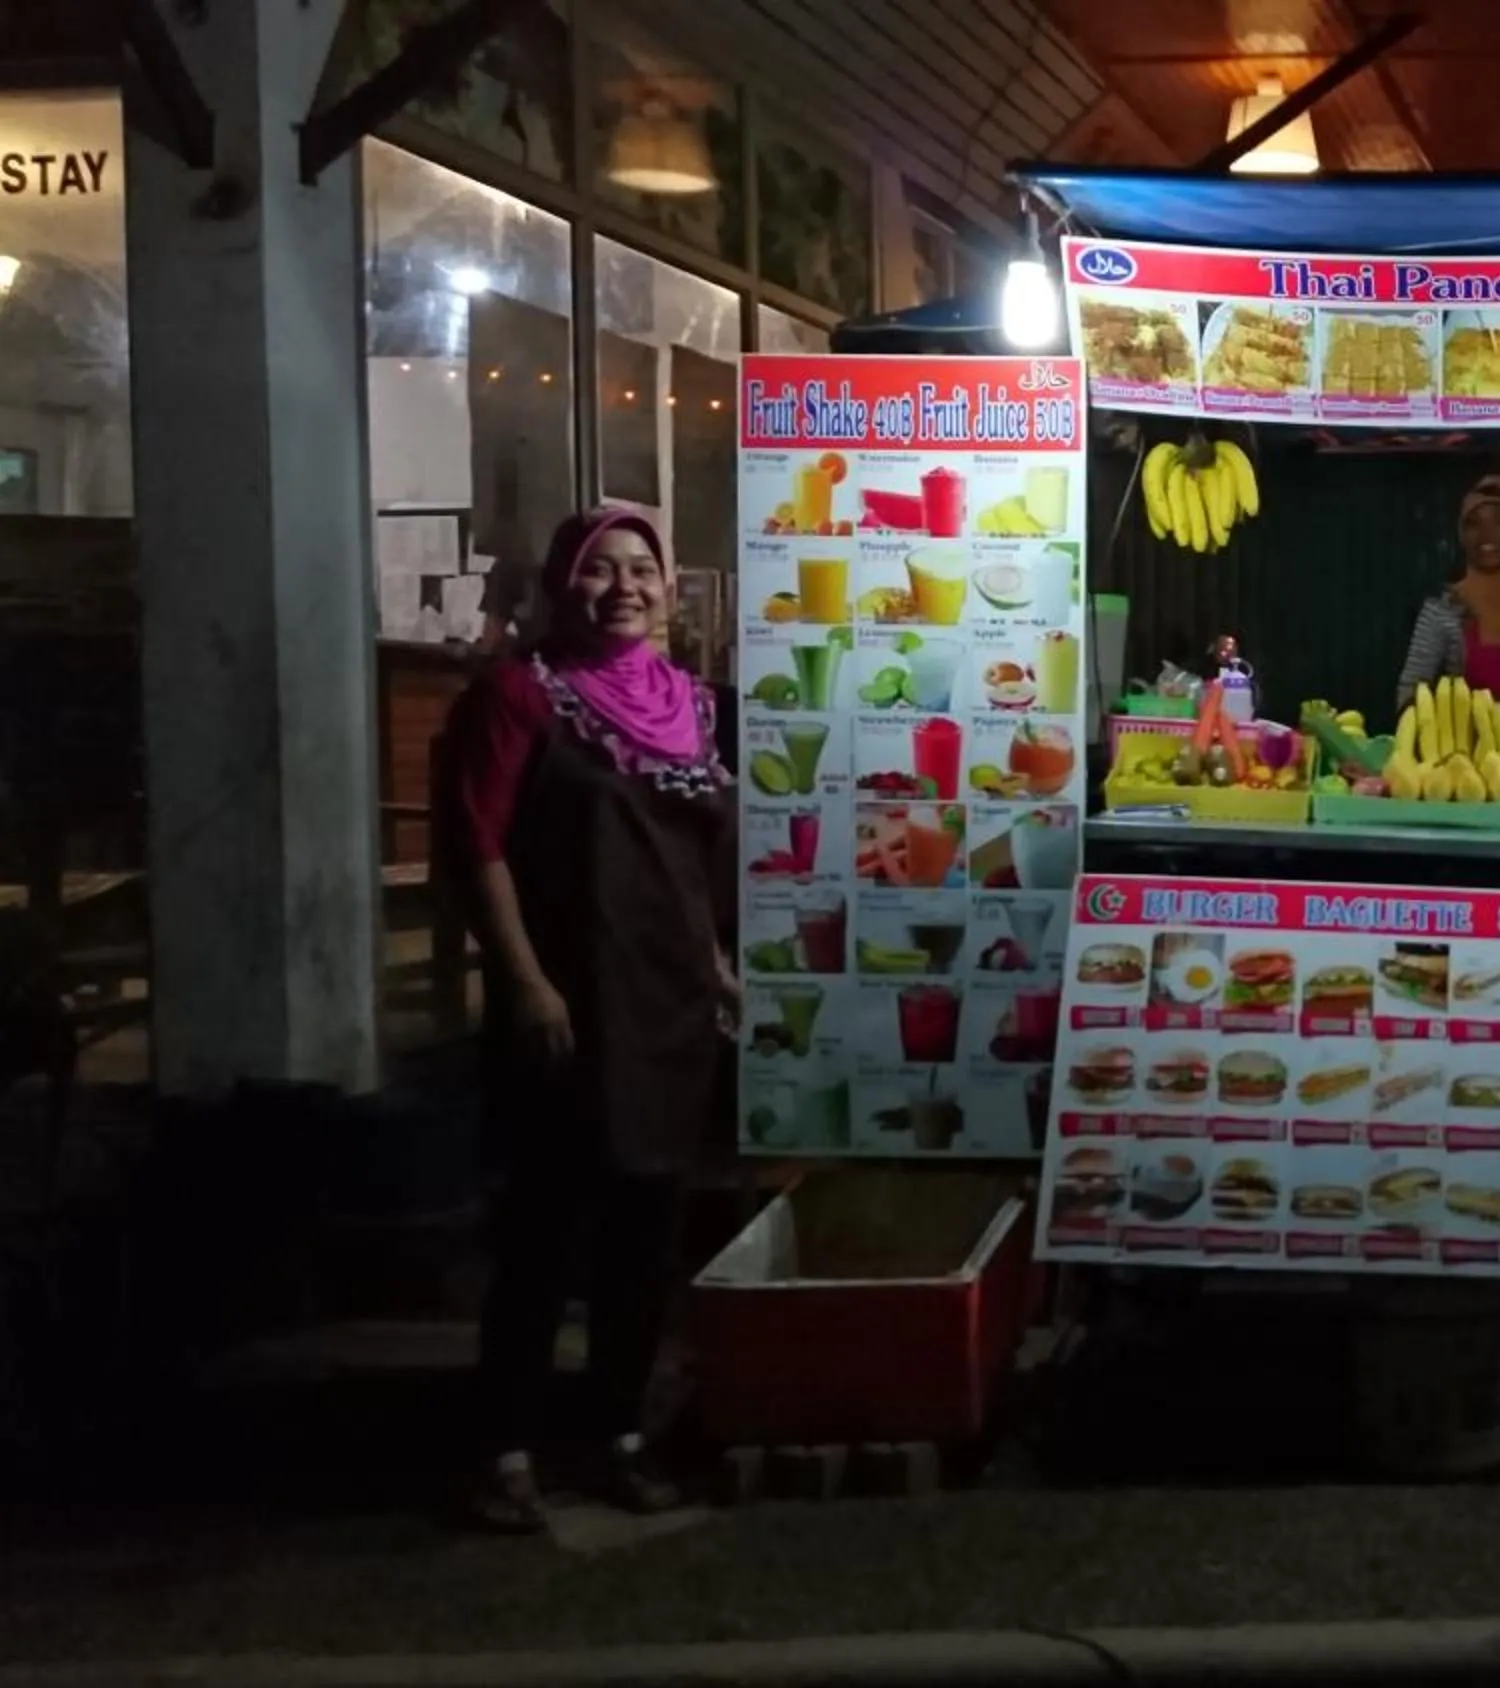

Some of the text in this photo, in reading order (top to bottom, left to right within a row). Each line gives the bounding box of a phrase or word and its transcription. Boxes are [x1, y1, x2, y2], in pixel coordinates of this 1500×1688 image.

[1, 150, 107, 196] STAY
[1259, 259, 1376, 301] Thai
[748, 381, 799, 438] Fruit
[804, 381, 867, 438] Shake
[919, 382, 970, 440] Fruit
[975, 384, 1028, 441] Juice
[1141, 888, 1279, 925] BURGER
[1303, 895, 1474, 933] BAGUETTE
